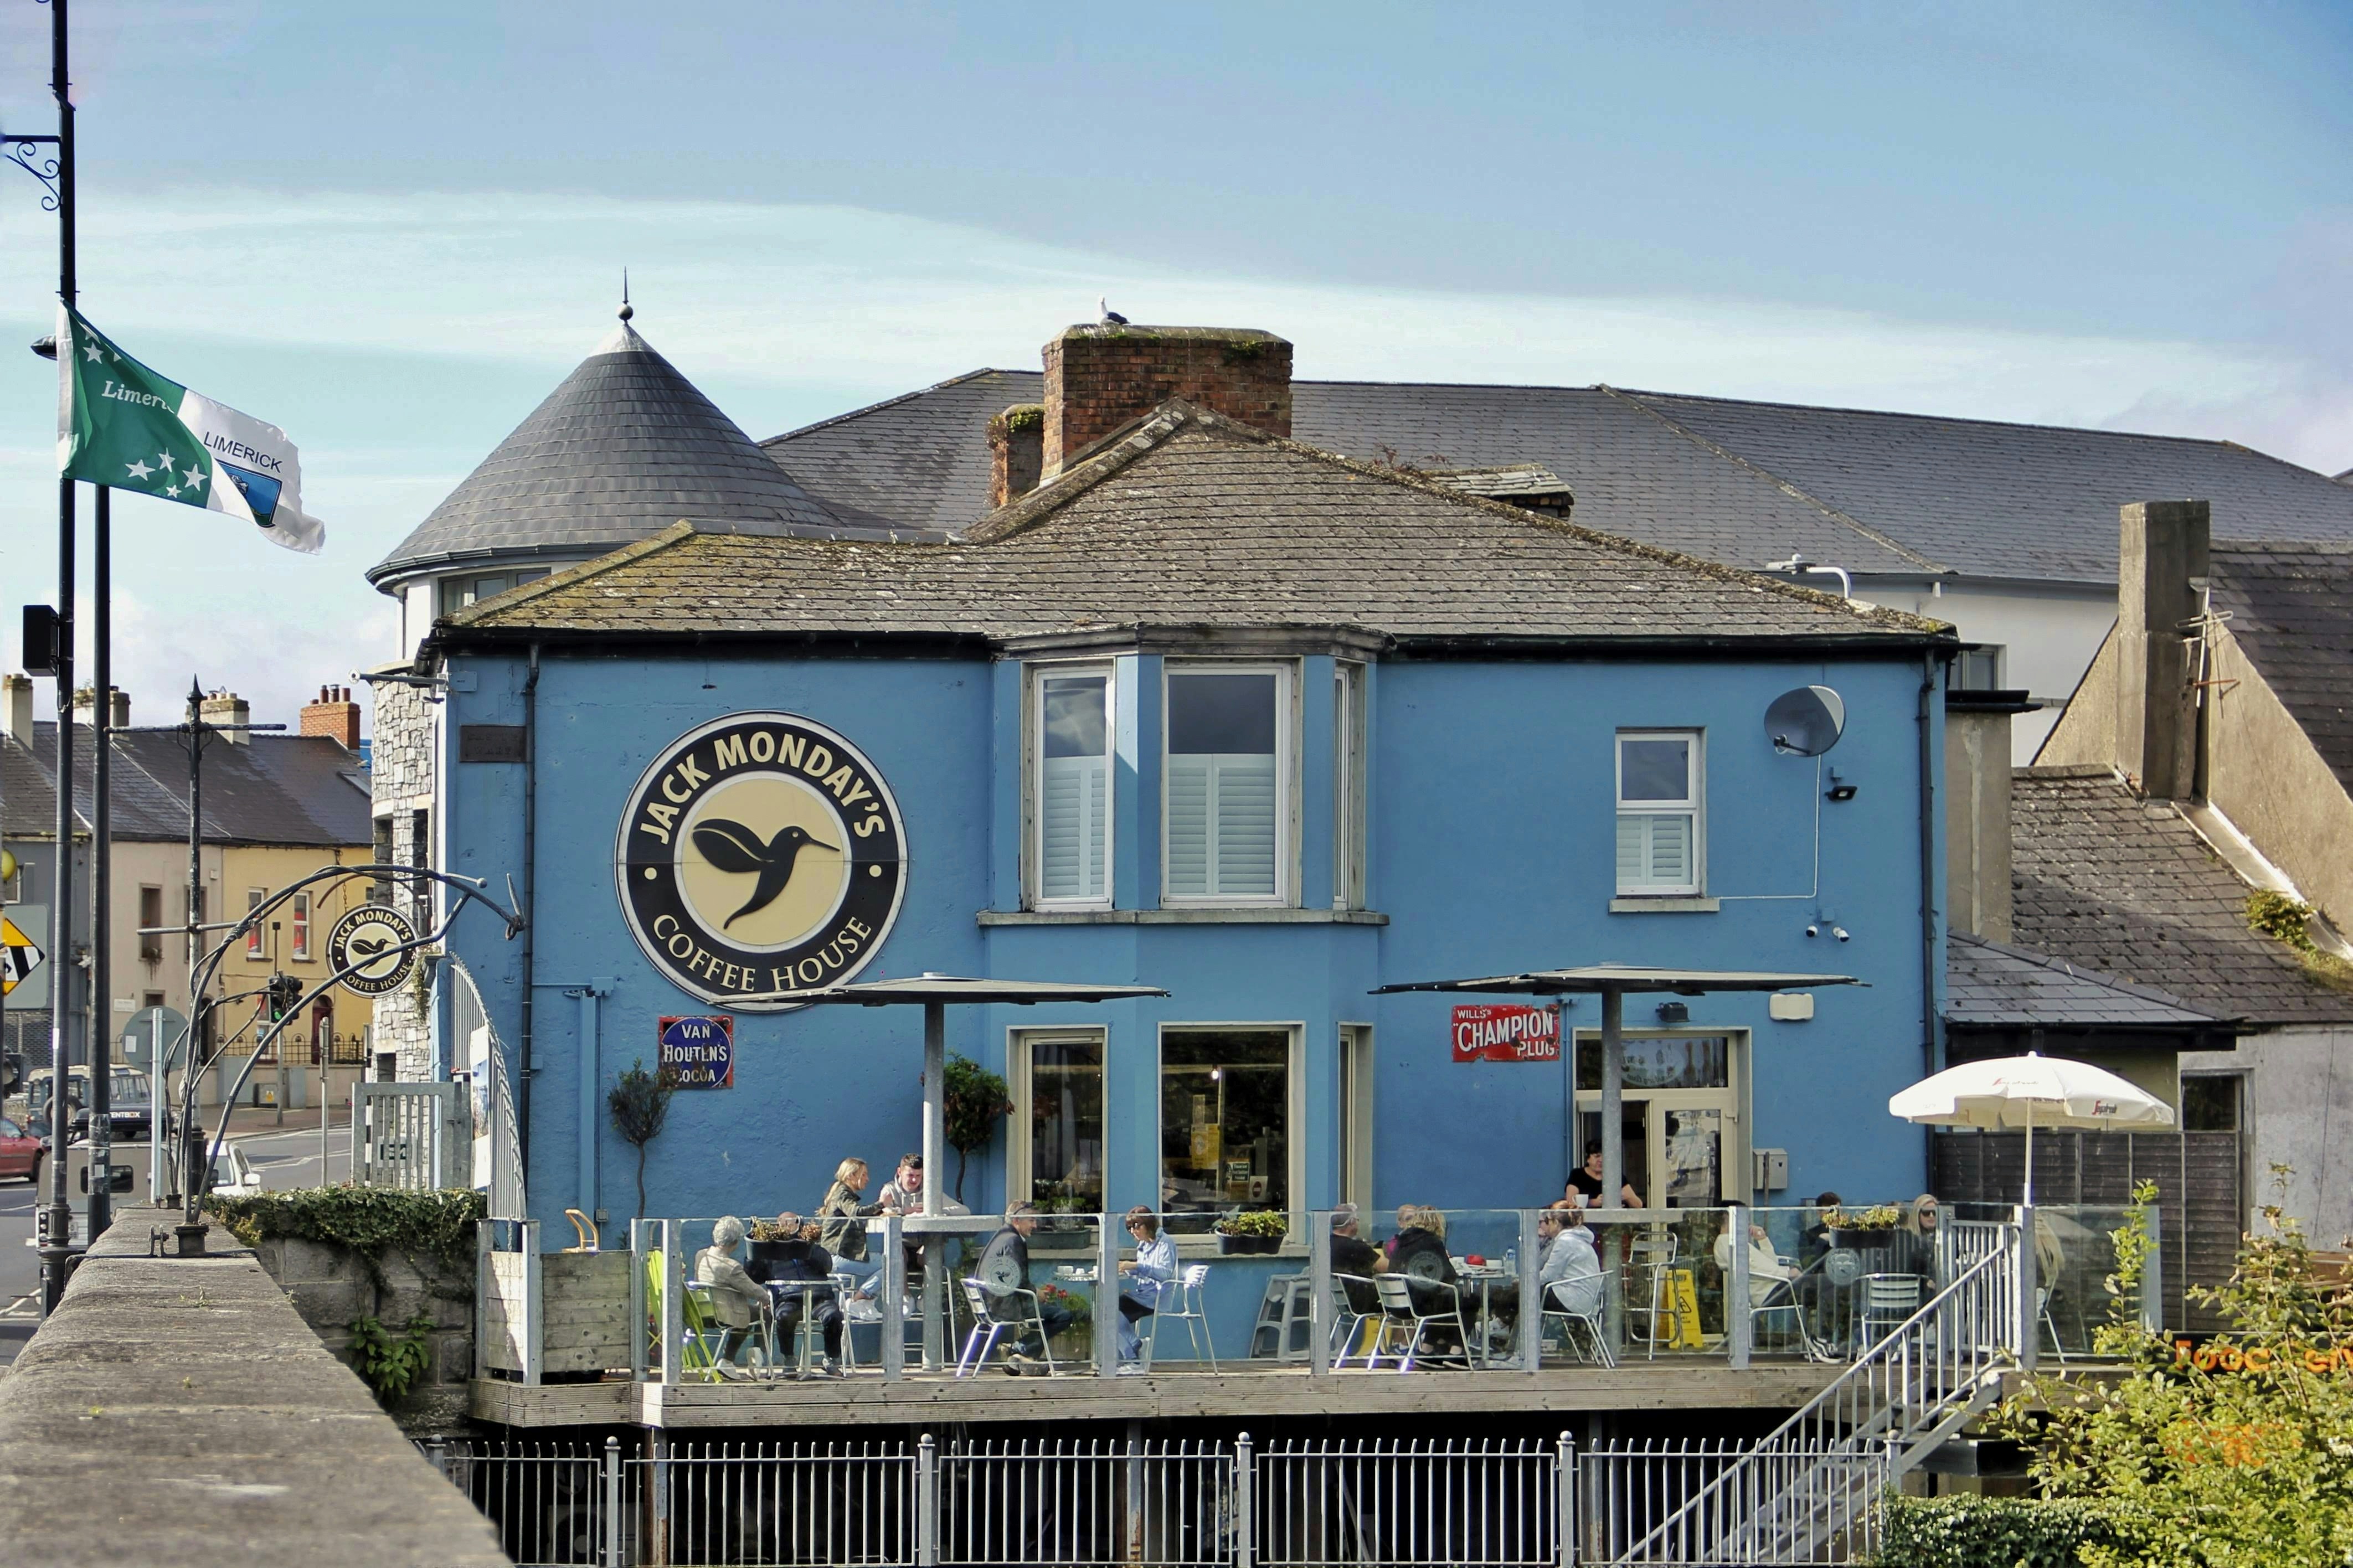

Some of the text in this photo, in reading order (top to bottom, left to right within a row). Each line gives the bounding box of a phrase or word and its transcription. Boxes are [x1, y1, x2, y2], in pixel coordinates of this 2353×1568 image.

[102, 380, 174, 414] Limeri
[204, 432, 282, 473] LIMERICK
[640, 731, 886, 844] JACK MONDAY'S
[334, 911, 411, 949] JACK MONDAY'S
[653, 915, 872, 991] COFFEE HOUSE
[347, 963, 410, 991] OFFEE HOUSE
[682, 1024, 710, 1039] VAN
[1517, 1040, 1555, 1056] PLUG
[677, 1069, 715, 1082] OCOA
